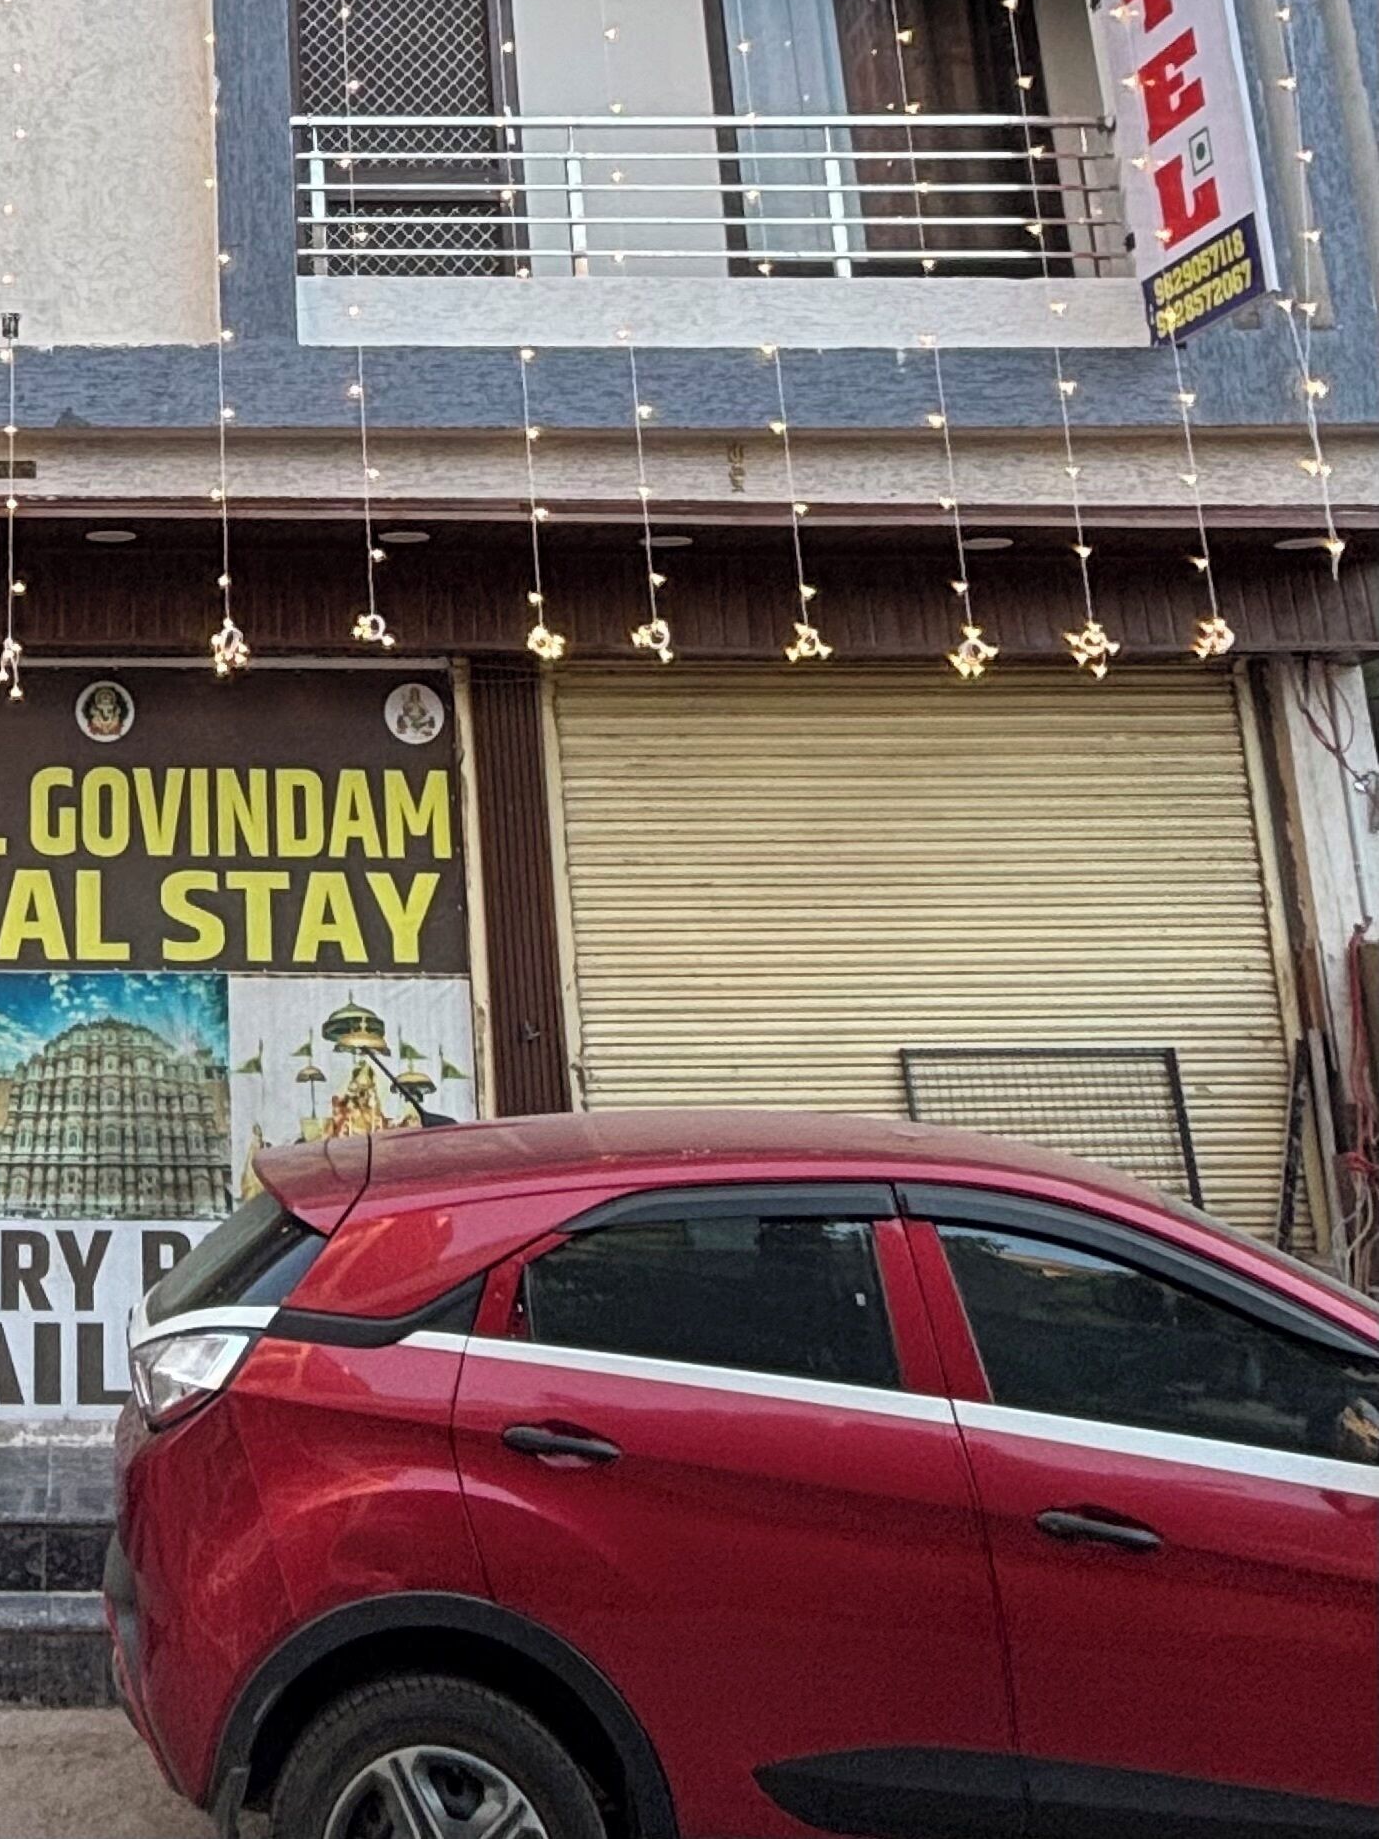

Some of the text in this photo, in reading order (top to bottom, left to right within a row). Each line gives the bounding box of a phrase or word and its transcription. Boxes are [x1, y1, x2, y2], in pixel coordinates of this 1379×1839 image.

[1153, 228, 1245, 307] 9829057118
[1155, 257, 1252, 339] 928572067
[29, 766, 453, 860] GOVINDAM
[160, 870, 442, 964] STAY
